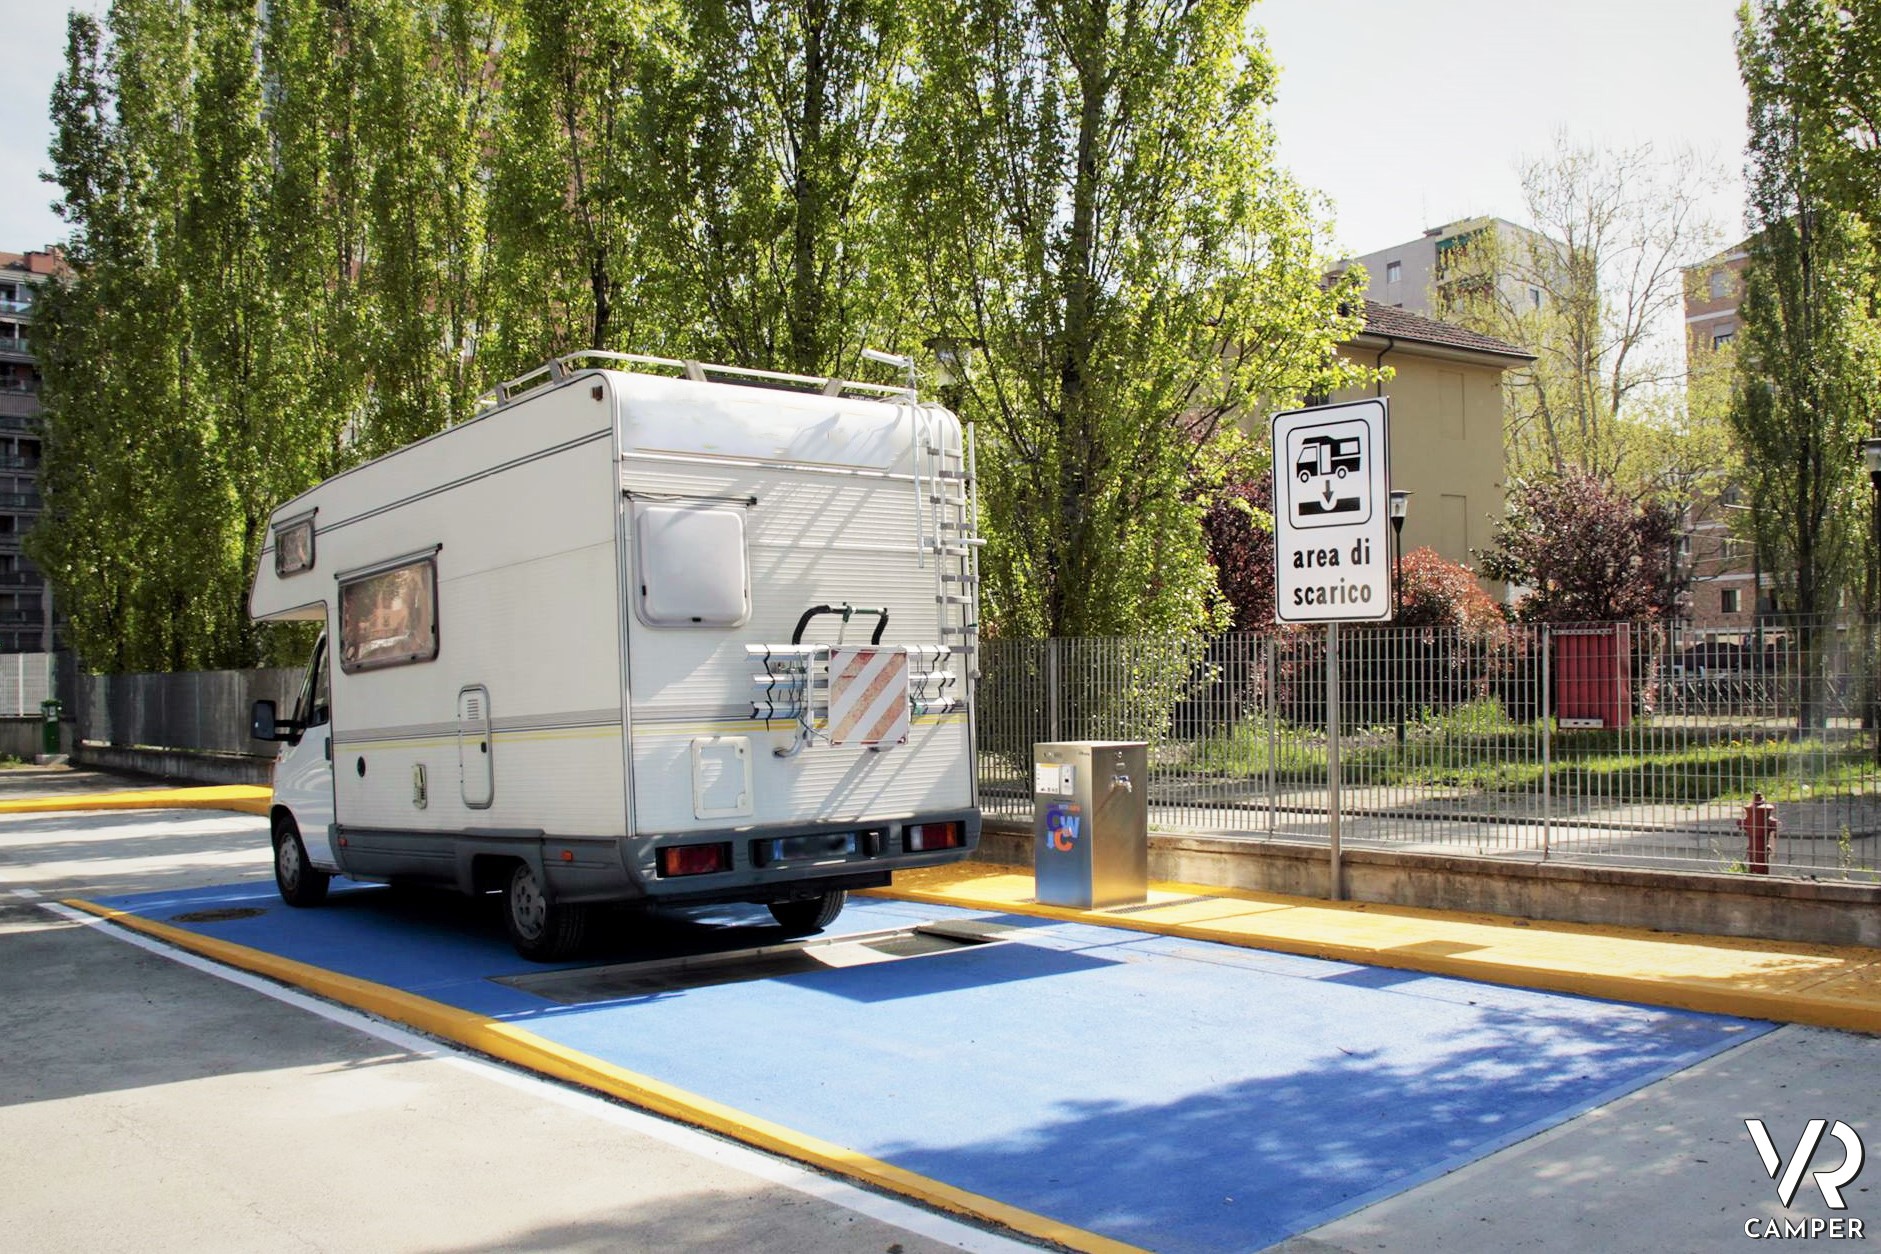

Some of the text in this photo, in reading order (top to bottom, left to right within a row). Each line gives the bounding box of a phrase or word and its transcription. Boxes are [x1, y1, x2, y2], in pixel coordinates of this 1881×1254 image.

[1293, 537, 1370, 569] area di
[1293, 576, 1371, 605] scarico
